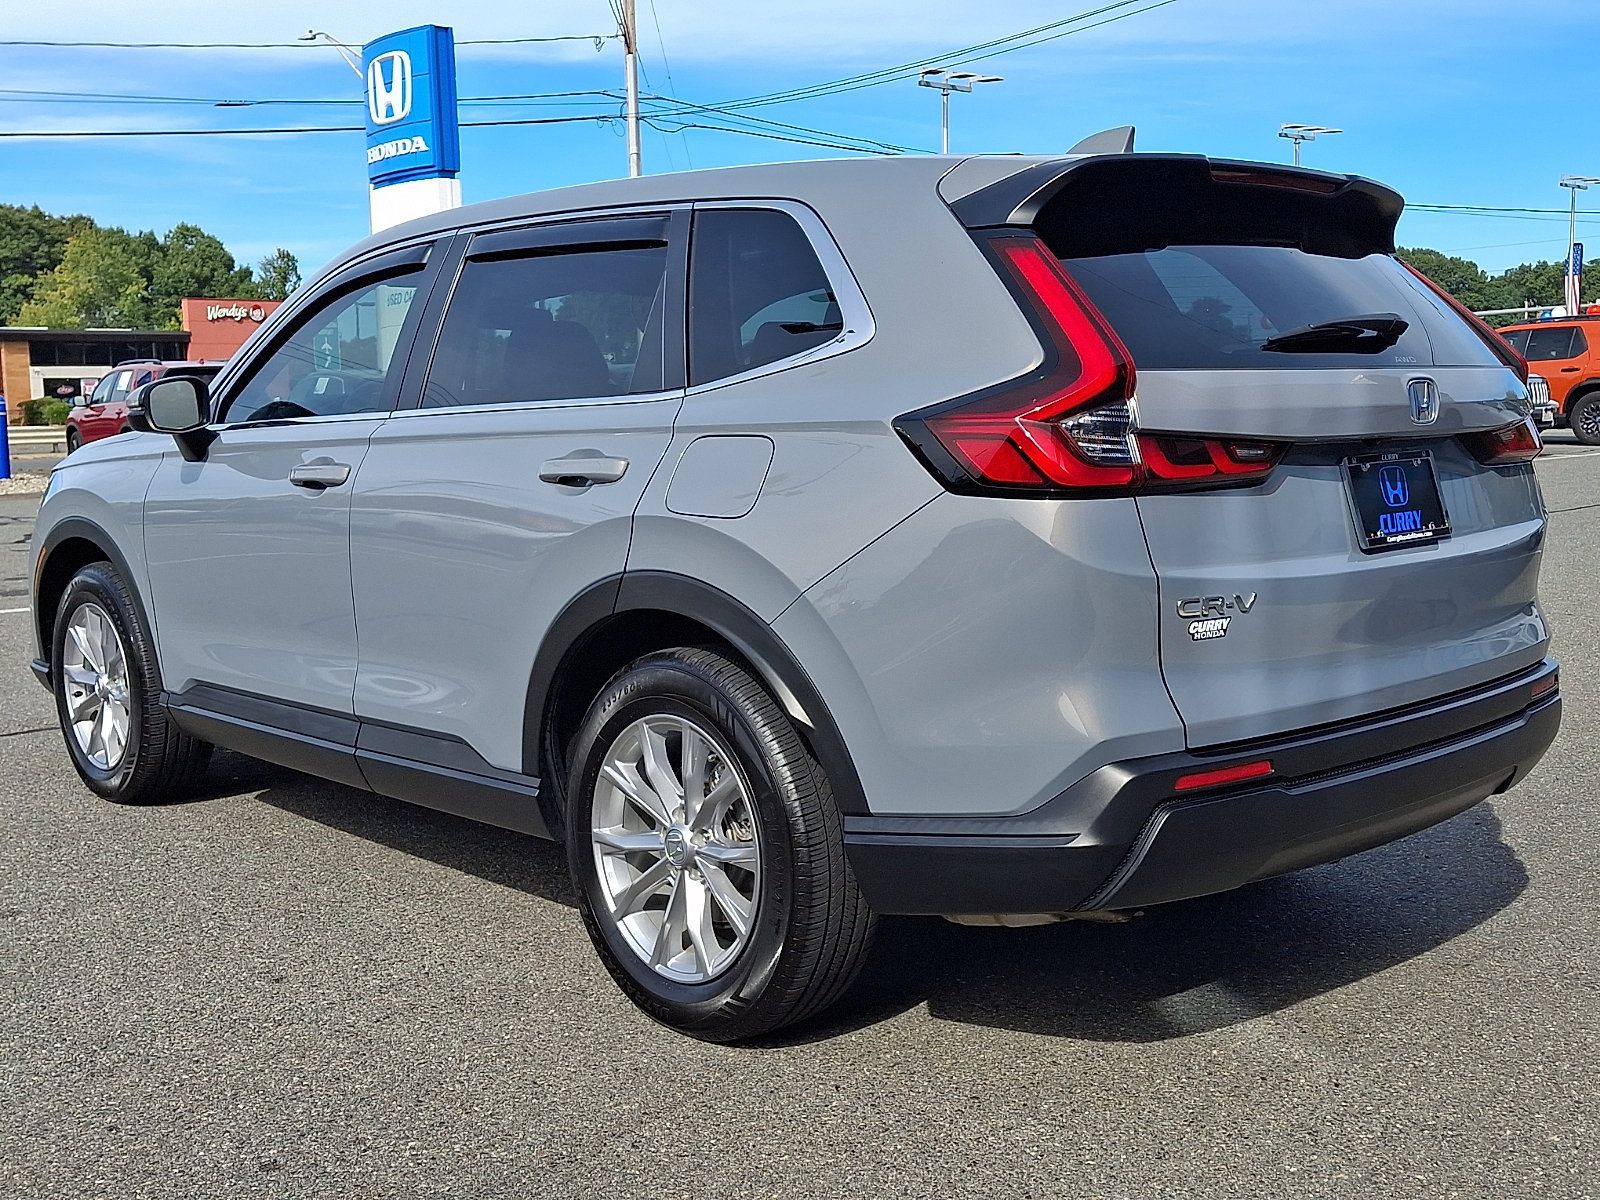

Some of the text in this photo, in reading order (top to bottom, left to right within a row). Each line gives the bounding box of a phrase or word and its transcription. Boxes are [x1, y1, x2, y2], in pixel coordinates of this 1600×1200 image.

[367, 136, 430, 164] HONDA
[1380, 510, 1422, 534] CURRY
[1176, 592, 1257, 619] CR-V
[1189, 617, 1231, 634] CURRY
[1193, 629, 1225, 640] HONDA
